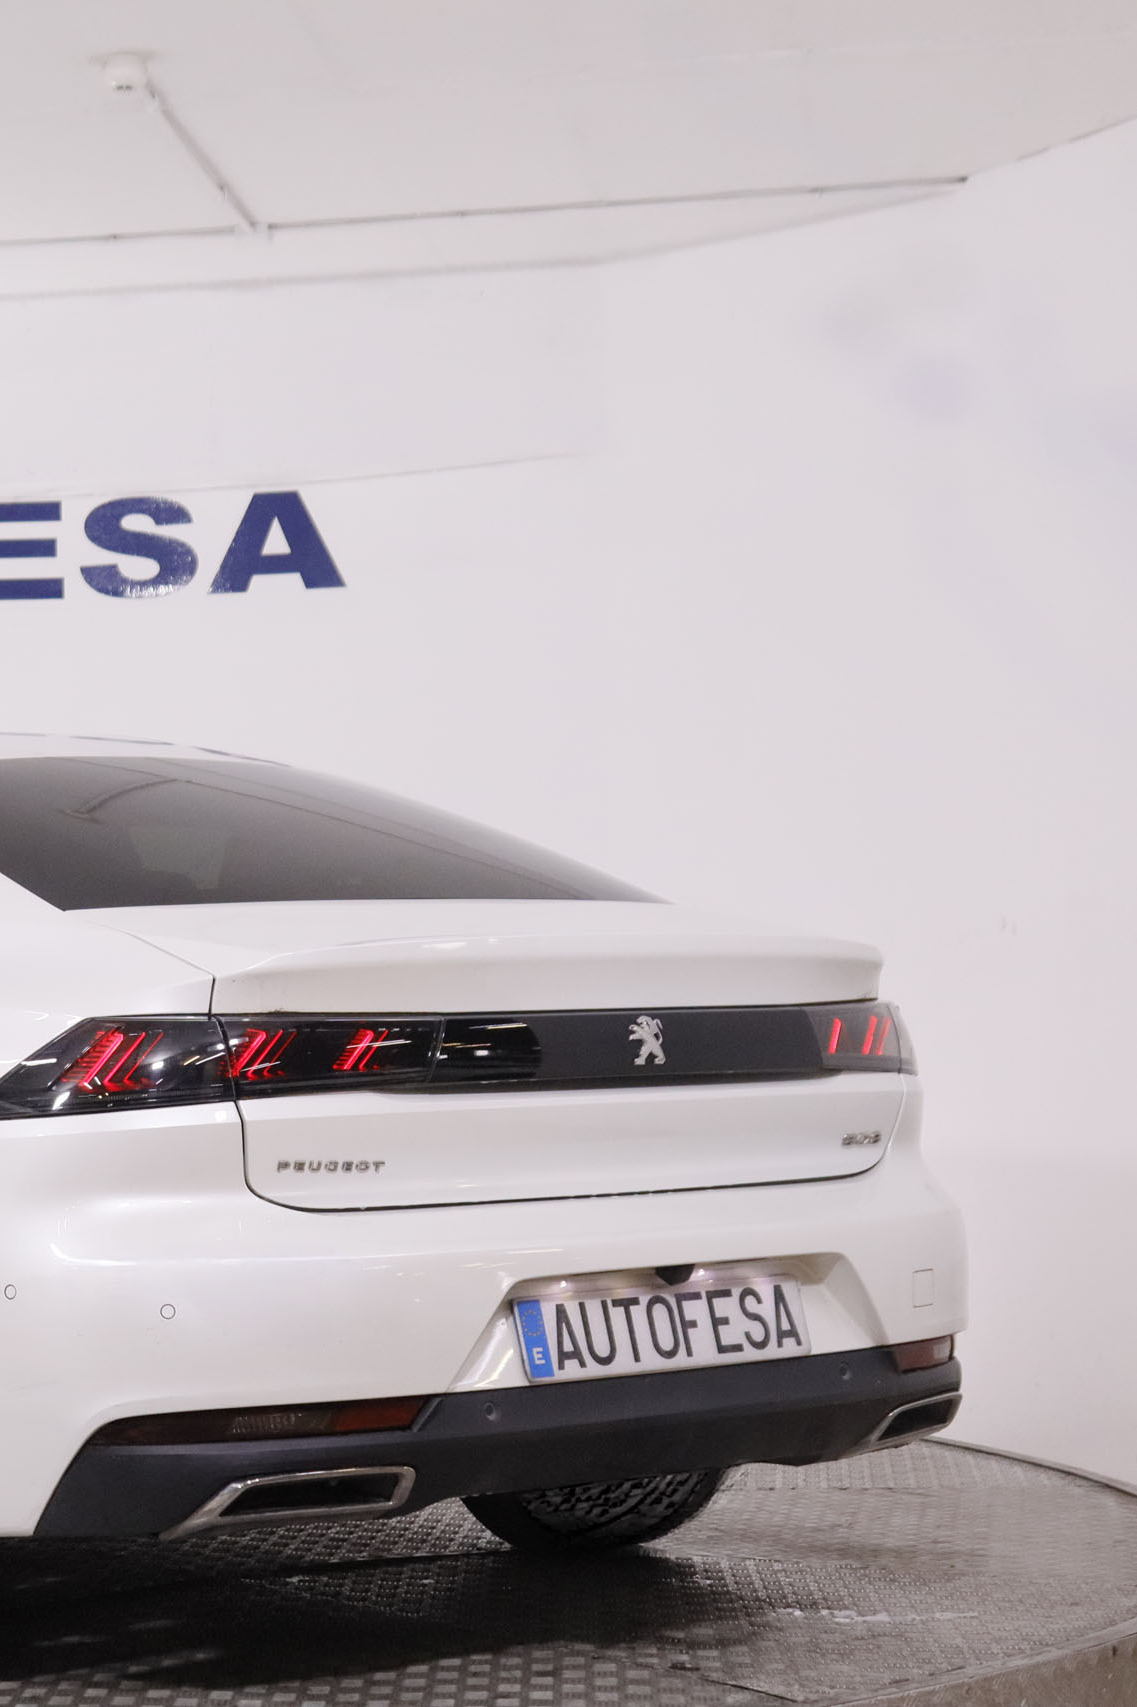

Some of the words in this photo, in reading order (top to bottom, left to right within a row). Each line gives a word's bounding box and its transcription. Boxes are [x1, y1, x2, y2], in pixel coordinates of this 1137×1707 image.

[276, 1160, 386, 1173] PEUGEOT
[533, 1347, 545, 1365] E
[555, 1284, 802, 1370] AUTOFESA
